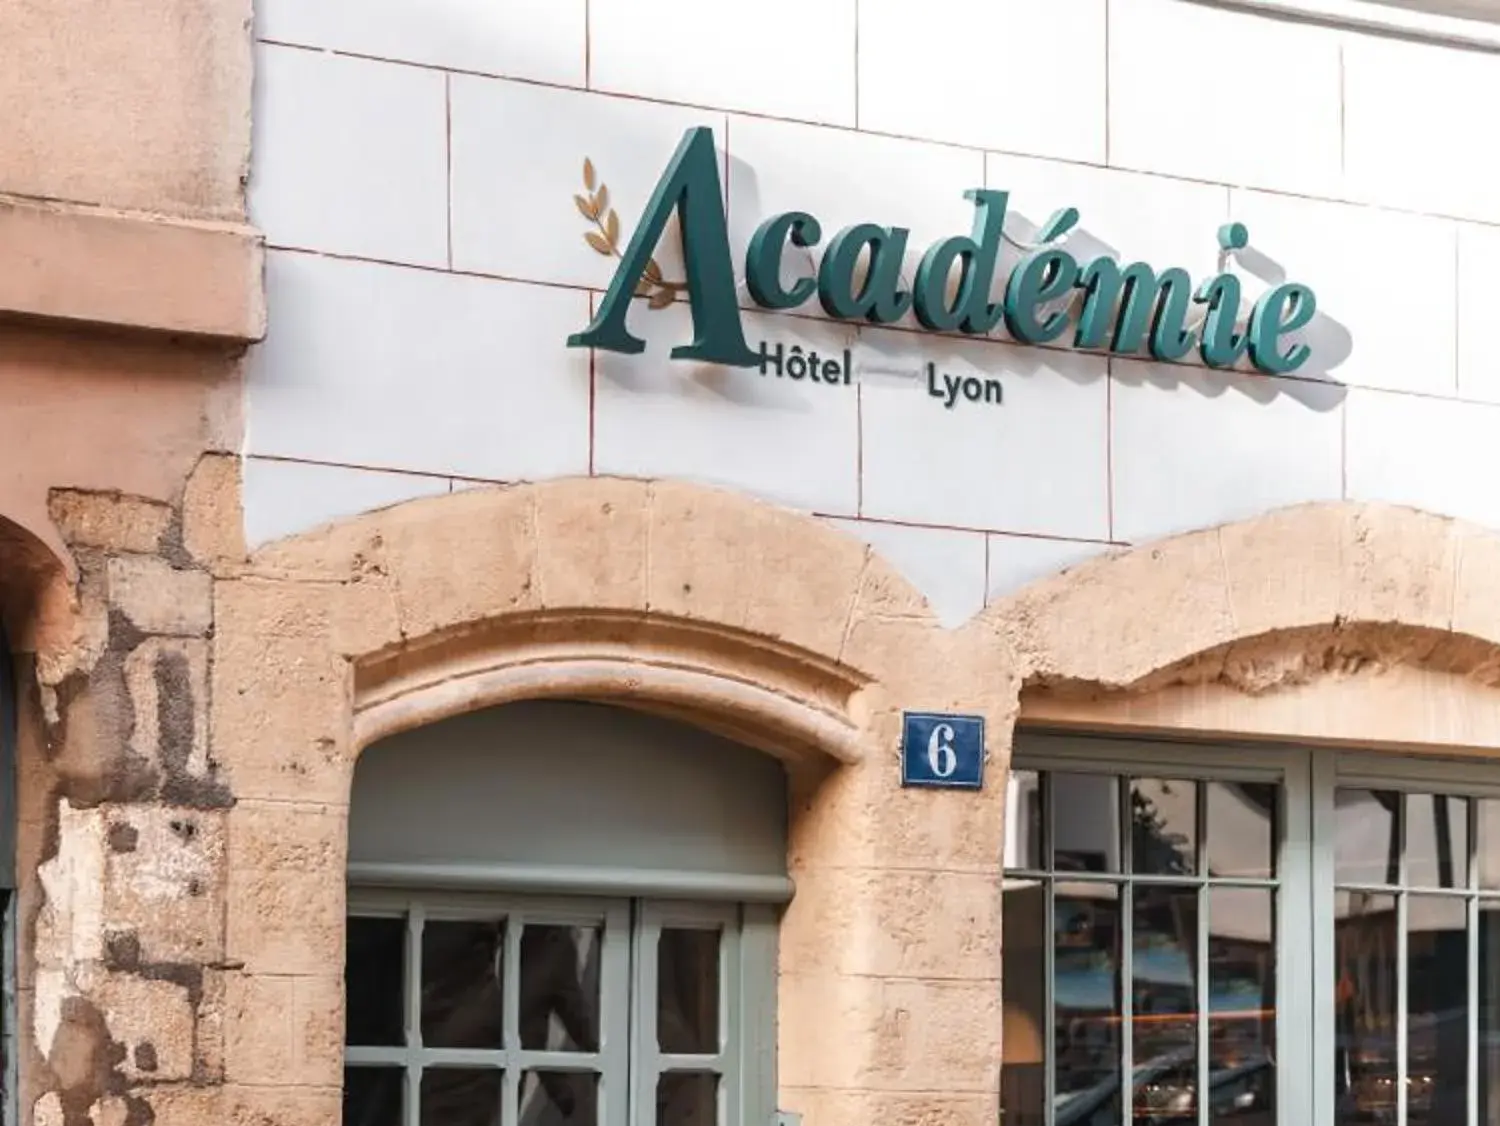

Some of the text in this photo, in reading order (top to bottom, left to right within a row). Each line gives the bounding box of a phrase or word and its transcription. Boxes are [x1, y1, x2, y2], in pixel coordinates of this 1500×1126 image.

[566, 125, 1317, 375] Académie
[759, 341, 1003, 409] Hôtel Lyon
[928, 723, 957, 777] 6
